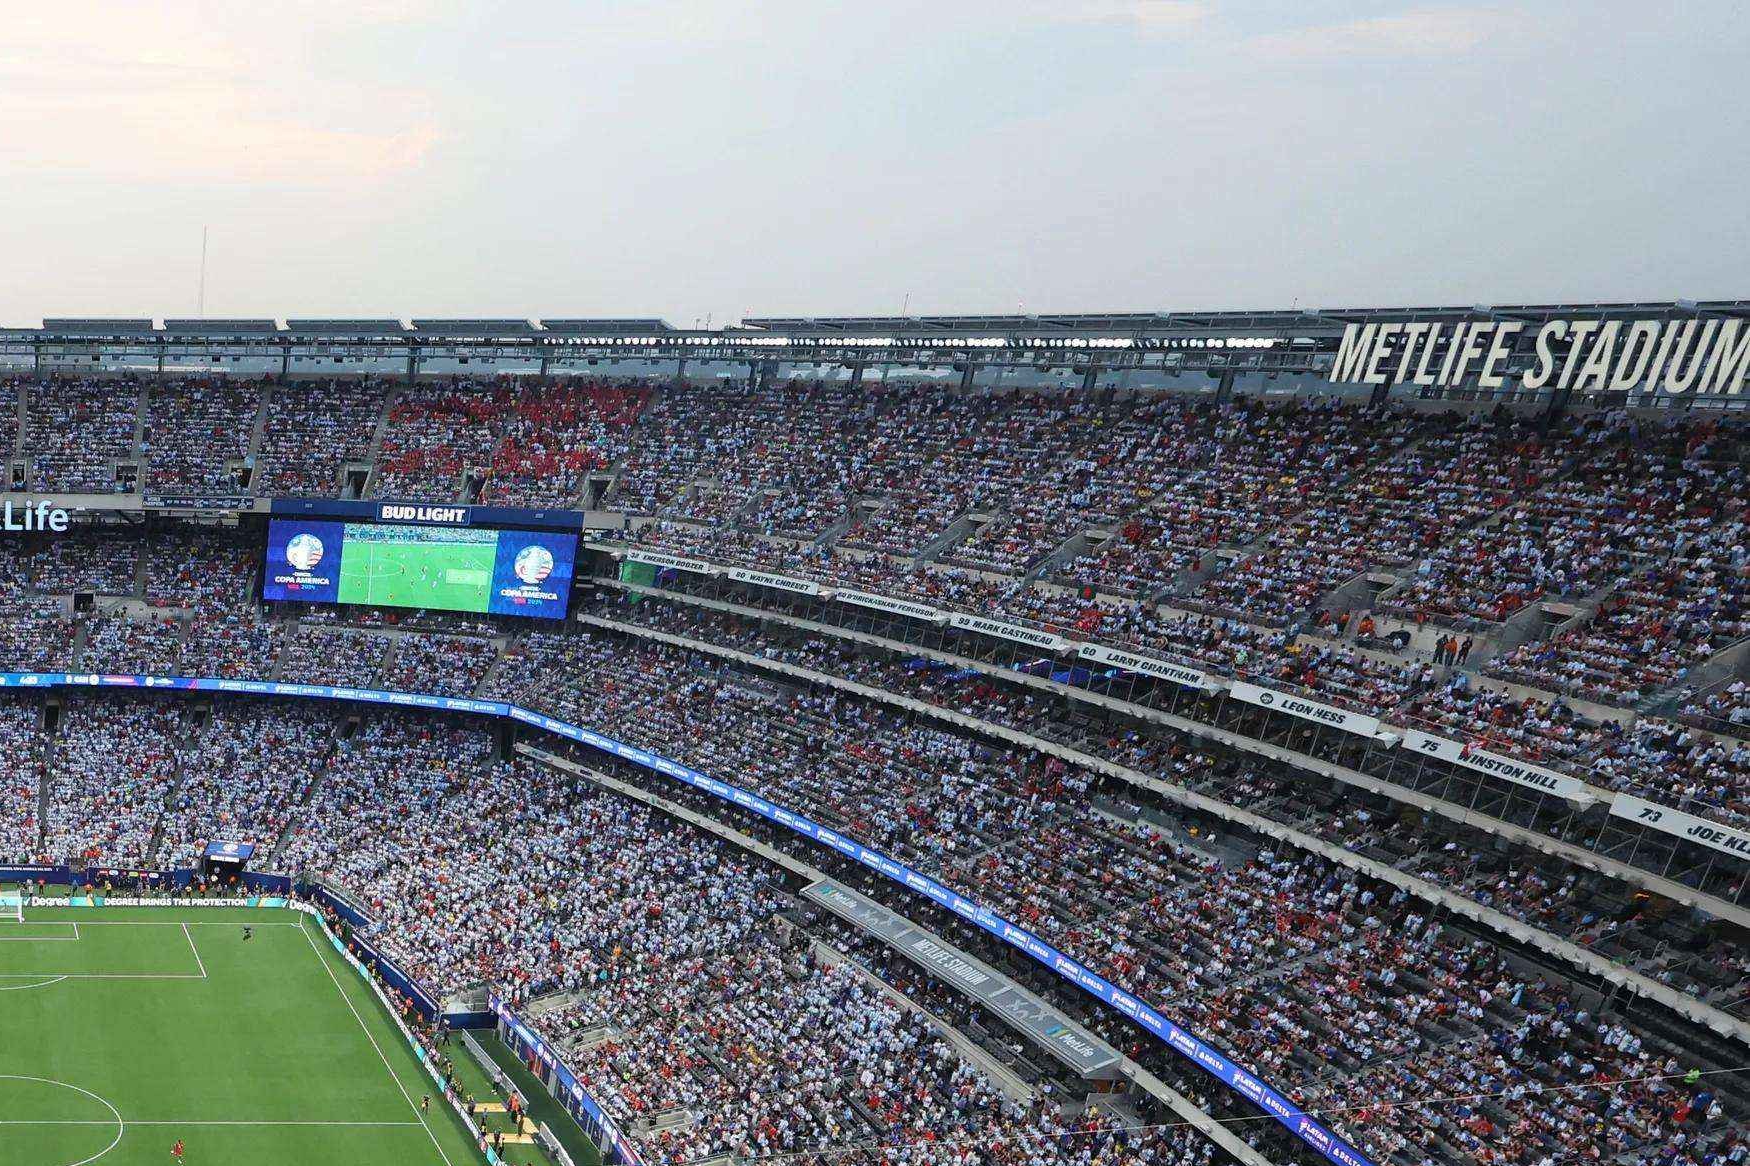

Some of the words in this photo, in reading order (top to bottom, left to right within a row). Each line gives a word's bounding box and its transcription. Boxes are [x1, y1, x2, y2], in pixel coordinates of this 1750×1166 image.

[1329, 322, 1524, 386] METLIFE
[1522, 319, 1750, 394] STADIUM
[381, 505, 415, 521] BUD
[416, 506, 466, 523] LIGHT
[295, 577, 330, 585] AMERICA
[749, 574, 774, 585] WAYNE
[972, 620, 1000, 634] MARK
[1001, 626, 1054, 646] GASTINEAU
[1082, 646, 1096, 656] 60
[1106, 653, 1140, 668] LARRY
[1140, 661, 1201, 684] GRANTHAM
[1280, 698, 1313, 717] LEON
[1313, 707, 1346, 725] HESS
[1420, 739, 1441, 752] 75
[1458, 751, 1525, 780] WINSTON
[1524, 771, 1558, 791] HILL
[1638, 808, 1663, 822] 73
[1687, 825, 1726, 843] JOE
[1723, 836, 1750, 855] KL
[31, 896, 71, 907] Degree
[104, 897, 138, 906] DEGREE
[139, 897, 172, 906] BRINGS
[173, 898, 190, 906] THE
[191, 898, 248, 907] PROTECTION
[911, 937, 950, 966] METLIFE
[944, 955, 990, 985] STADIUM
[1144, 1013, 1162, 1030] DELTA
[1059, 1031, 1094, 1058] MetLife
[1175, 1033, 1196, 1050] LATAM
[1204, 1053, 1224, 1071] DELTA
[1240, 1075, 1262, 1095] LATAM
[1270, 1098, 1290, 1118] DELTA
[1306, 1123, 1329, 1145] LATAM
